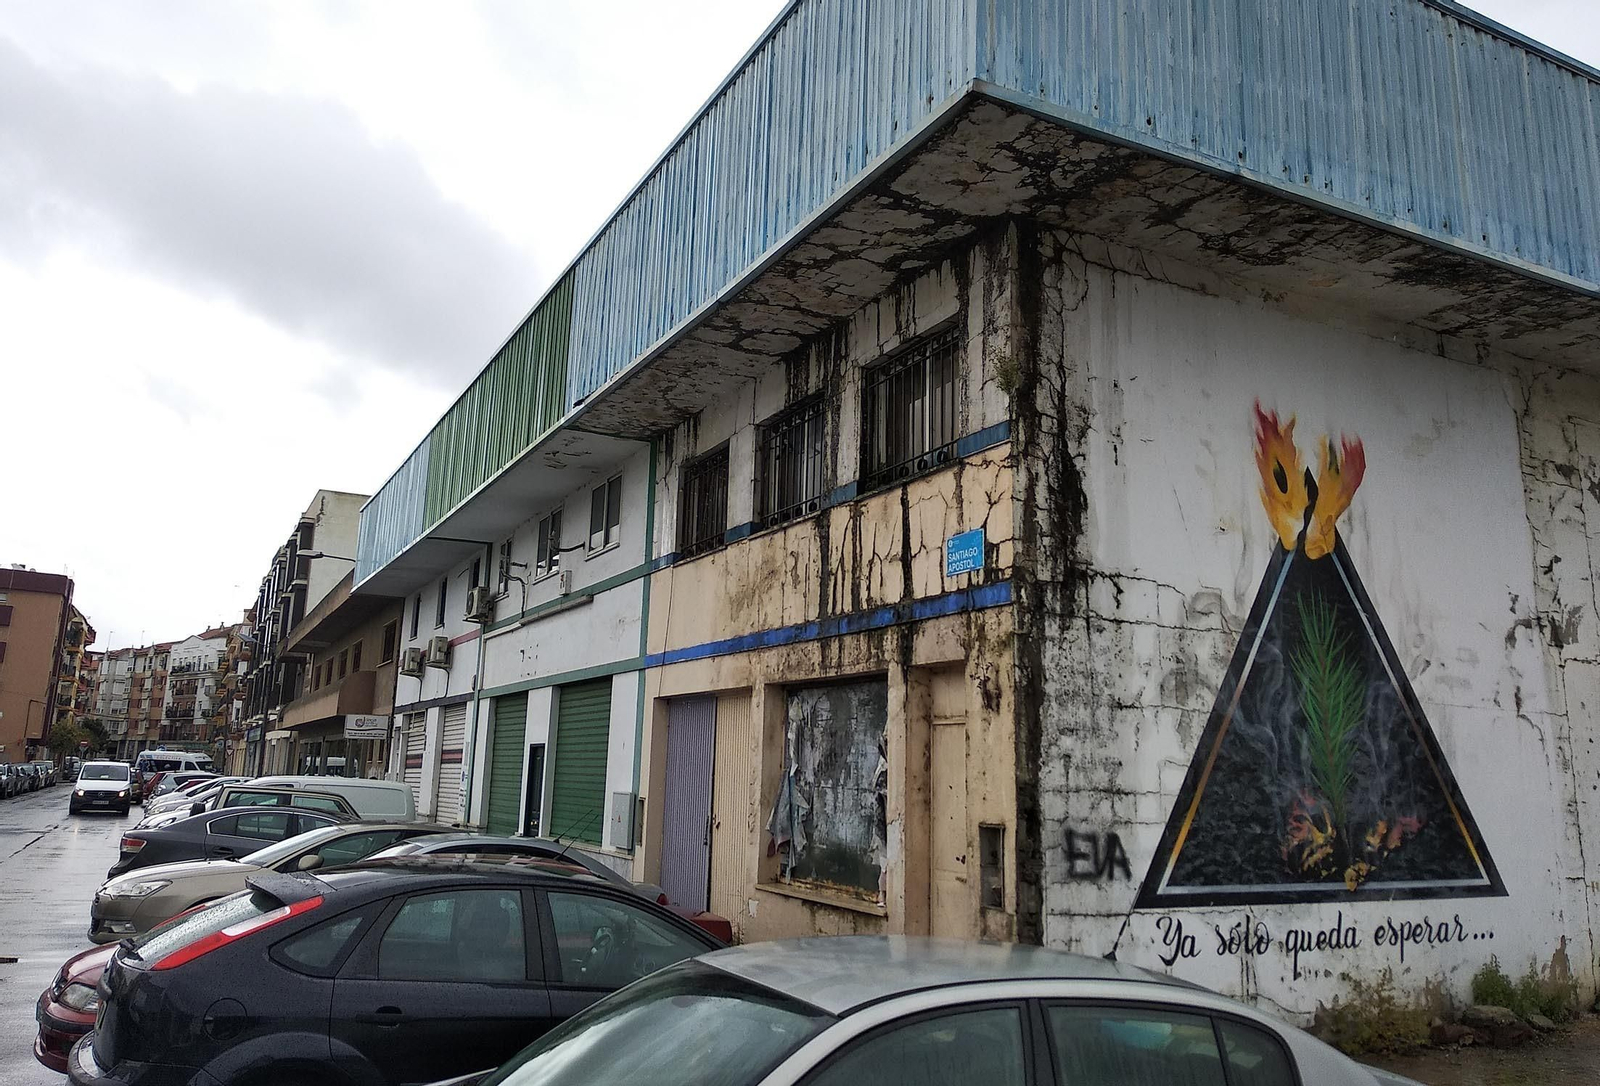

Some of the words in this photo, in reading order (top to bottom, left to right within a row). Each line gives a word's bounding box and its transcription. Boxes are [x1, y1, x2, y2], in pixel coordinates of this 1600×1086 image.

[948, 547, 978, 562] SANTIAGO
[1156, 916, 1201, 966] Ya
[1215, 914, 1273, 956] sólo
[1285, 910, 1362, 981] queda
